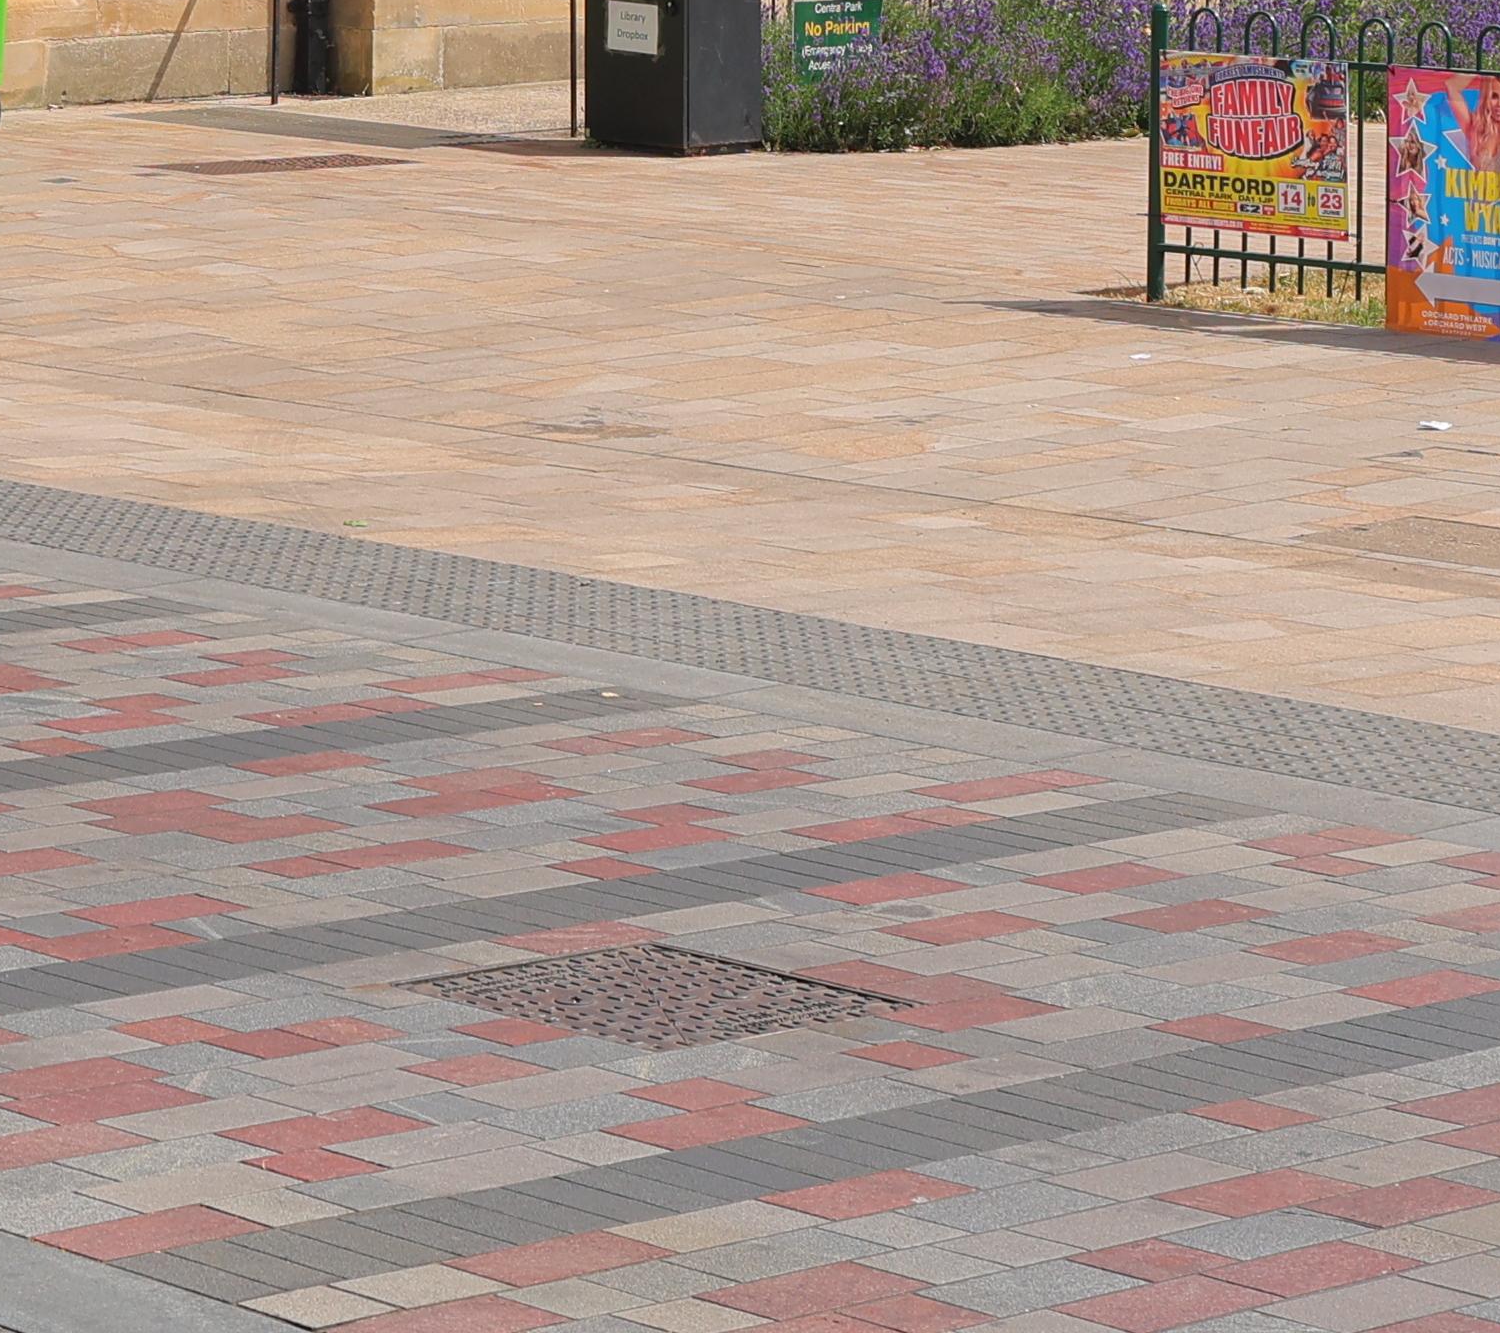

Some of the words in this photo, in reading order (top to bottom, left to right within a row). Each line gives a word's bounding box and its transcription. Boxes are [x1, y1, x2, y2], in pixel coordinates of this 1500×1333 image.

[845, 1, 863, 12] Park
[620, 11, 646, 24] Library
[617, 29, 648, 40] Dropbox
[805, 22, 822, 36] No
[1211, 78, 1294, 116] FAMILY
[1208, 114, 1302, 158] FUNFAIR
[1163, 152, 1185, 167] FREE
[1187, 154, 1222, 171] ENTRY!
[1164, 171, 1275, 196] DARTFORD
[1165, 188, 1207, 199] CENTRAL
[1208, 191, 1232, 200] PARK
[1280, 191, 1302, 206] 14
[1307, 193, 1315, 207] to
[1320, 194, 1342, 209] 23
[1442, 246, 1464, 265] ACTS
[1421, 310, 1460, 321] ORCHARD
[1428, 319, 1464, 329] ORCHARD
[1465, 323, 1487, 332] WEST
